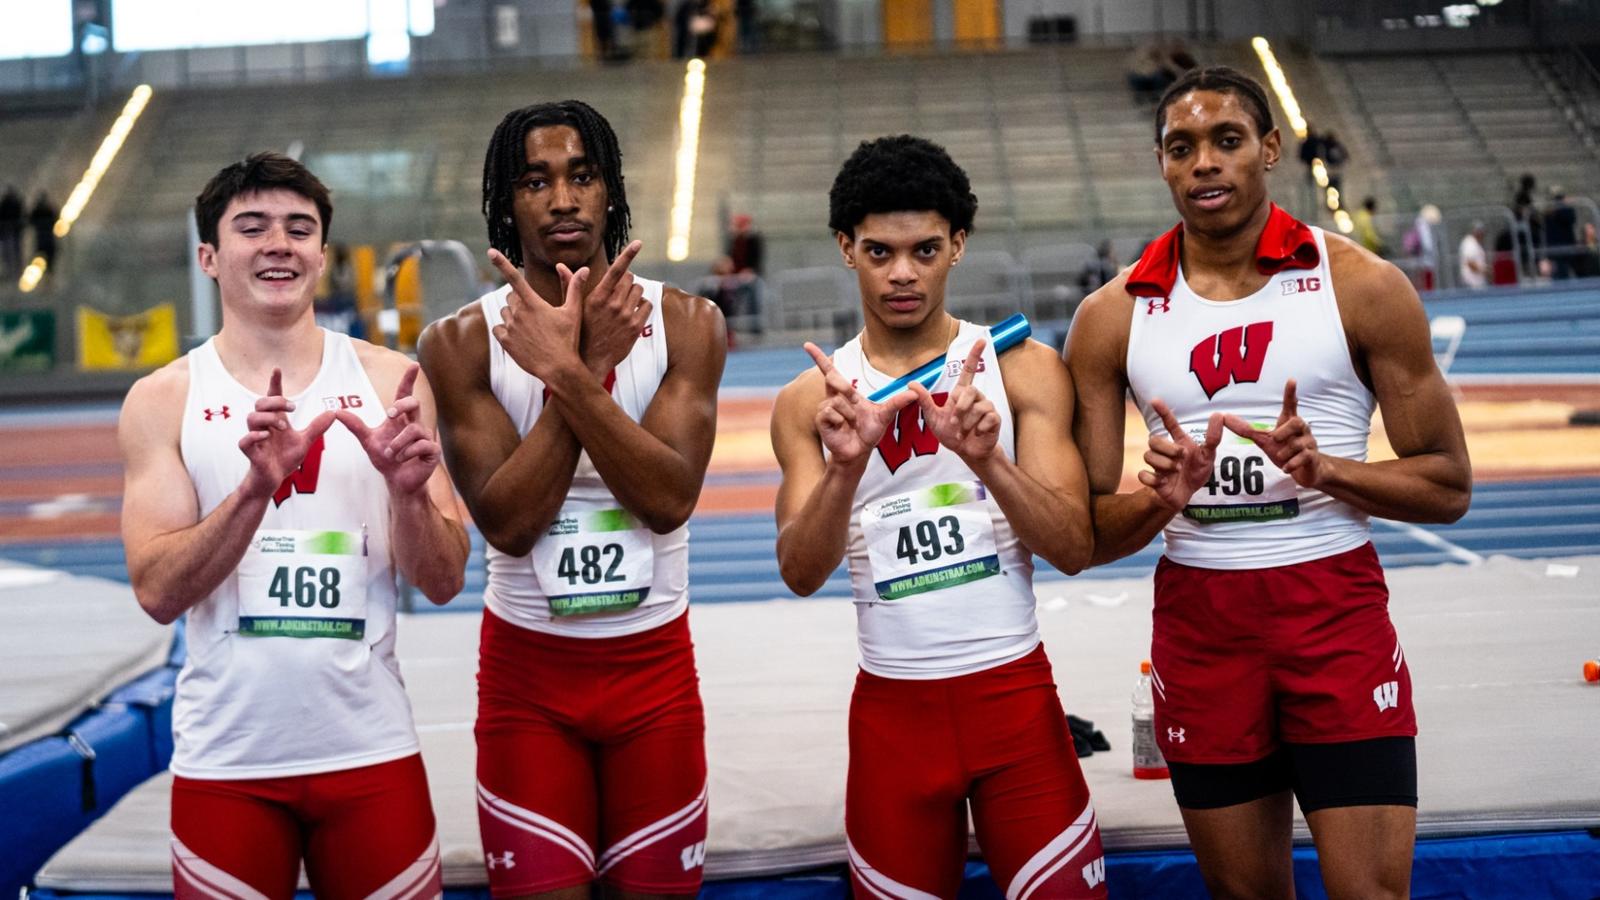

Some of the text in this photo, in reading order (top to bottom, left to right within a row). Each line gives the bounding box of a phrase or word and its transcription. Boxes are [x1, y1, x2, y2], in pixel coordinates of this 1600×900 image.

[1189, 321, 1274, 401] W
[896, 515, 965, 565] 493
[557, 543, 626, 585] 482
[268, 566, 341, 608] 468
[1373, 681, 1399, 712] W
[1082, 856, 1105, 889] W
